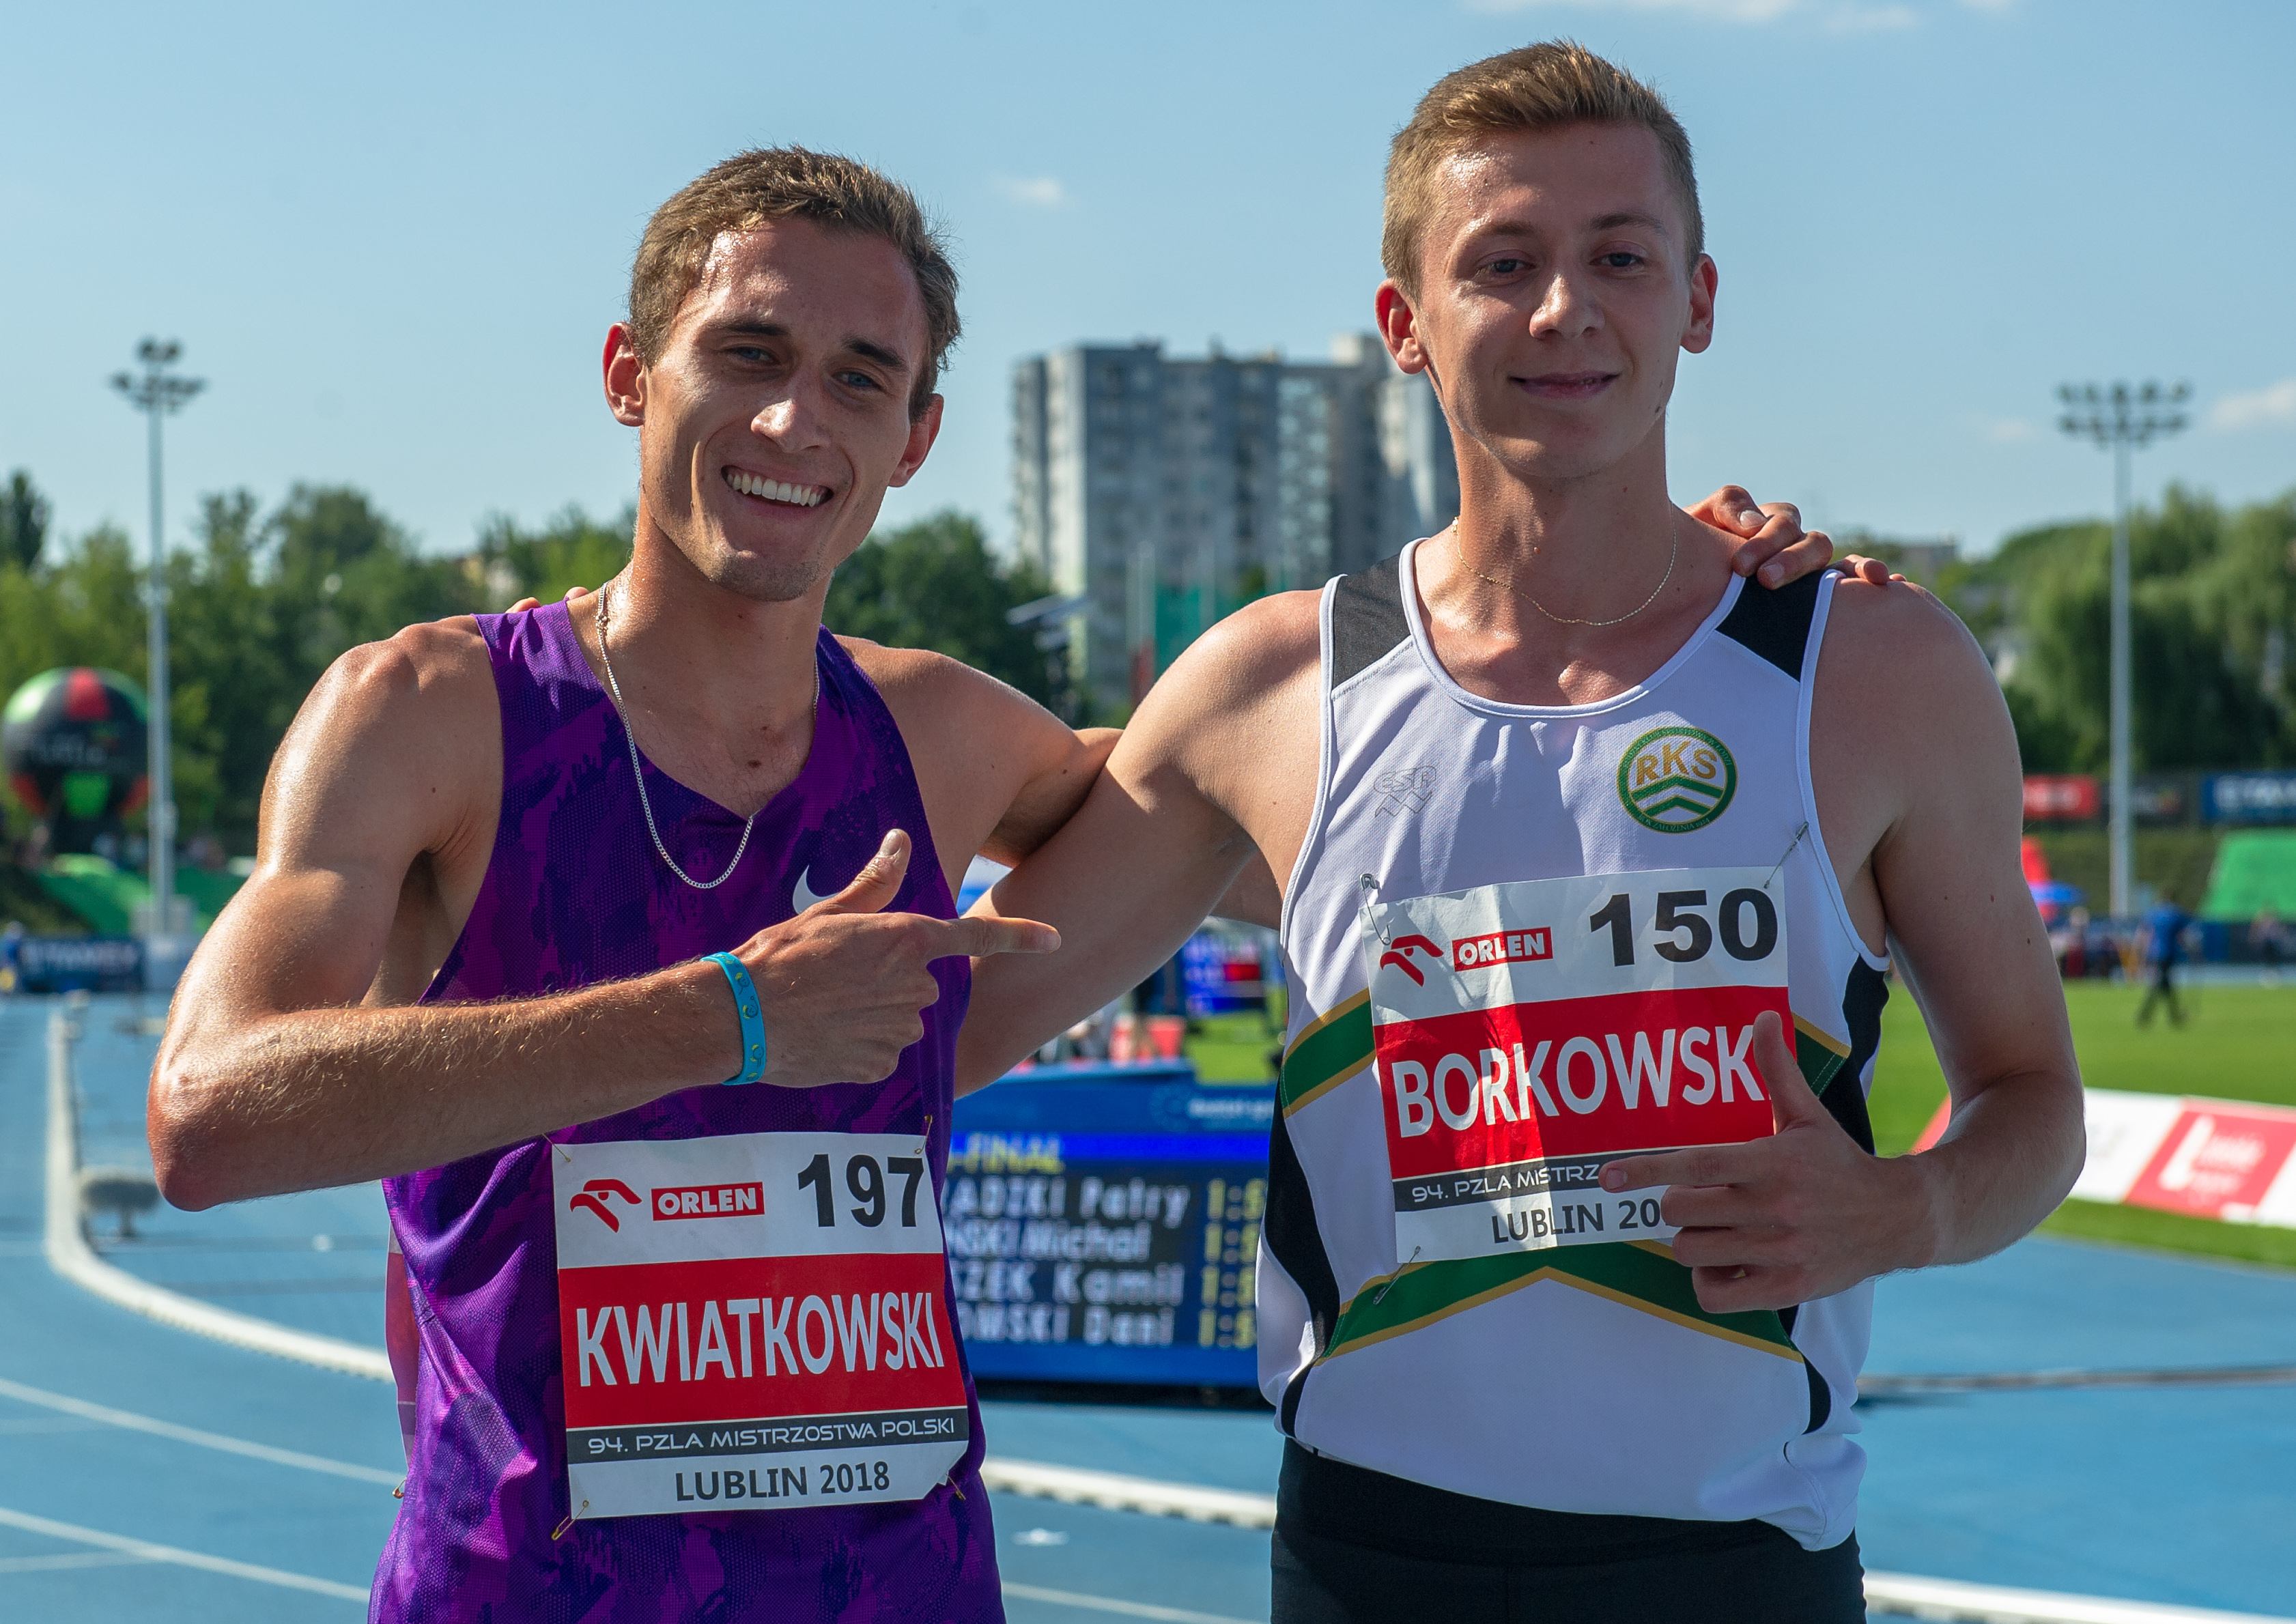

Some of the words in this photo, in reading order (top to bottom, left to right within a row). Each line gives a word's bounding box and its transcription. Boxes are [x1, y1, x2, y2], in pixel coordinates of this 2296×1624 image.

[1636, 741, 1717, 786] RKS
[1458, 932, 1544, 965] ORLEN
[1590, 888, 1778, 967] 150
[1391, 1024, 1772, 1139] BORKOWSK
[658, 1187, 757, 1215] ORLEN
[797, 1154, 924, 1227] 197
[1412, 1186, 1449, 1203] 94.
[1455, 1175, 1512, 1197] PZLA
[1517, 1164, 1600, 1188] MISTRZ
[1492, 1203, 1604, 1244] LUBLIN
[1618, 1198, 1667, 1229] 20
[576, 1292, 944, 1386] KWIATKOWSKI
[589, 1437, 628, 1455] 94.
[636, 1434, 704, 1451] PZLA
[710, 1422, 877, 1448] MISTRZOSTWA
[881, 1418, 955, 1437] POLSKI
[676, 1466, 808, 1501] LUBLIN
[820, 1461, 890, 1494] 2018
